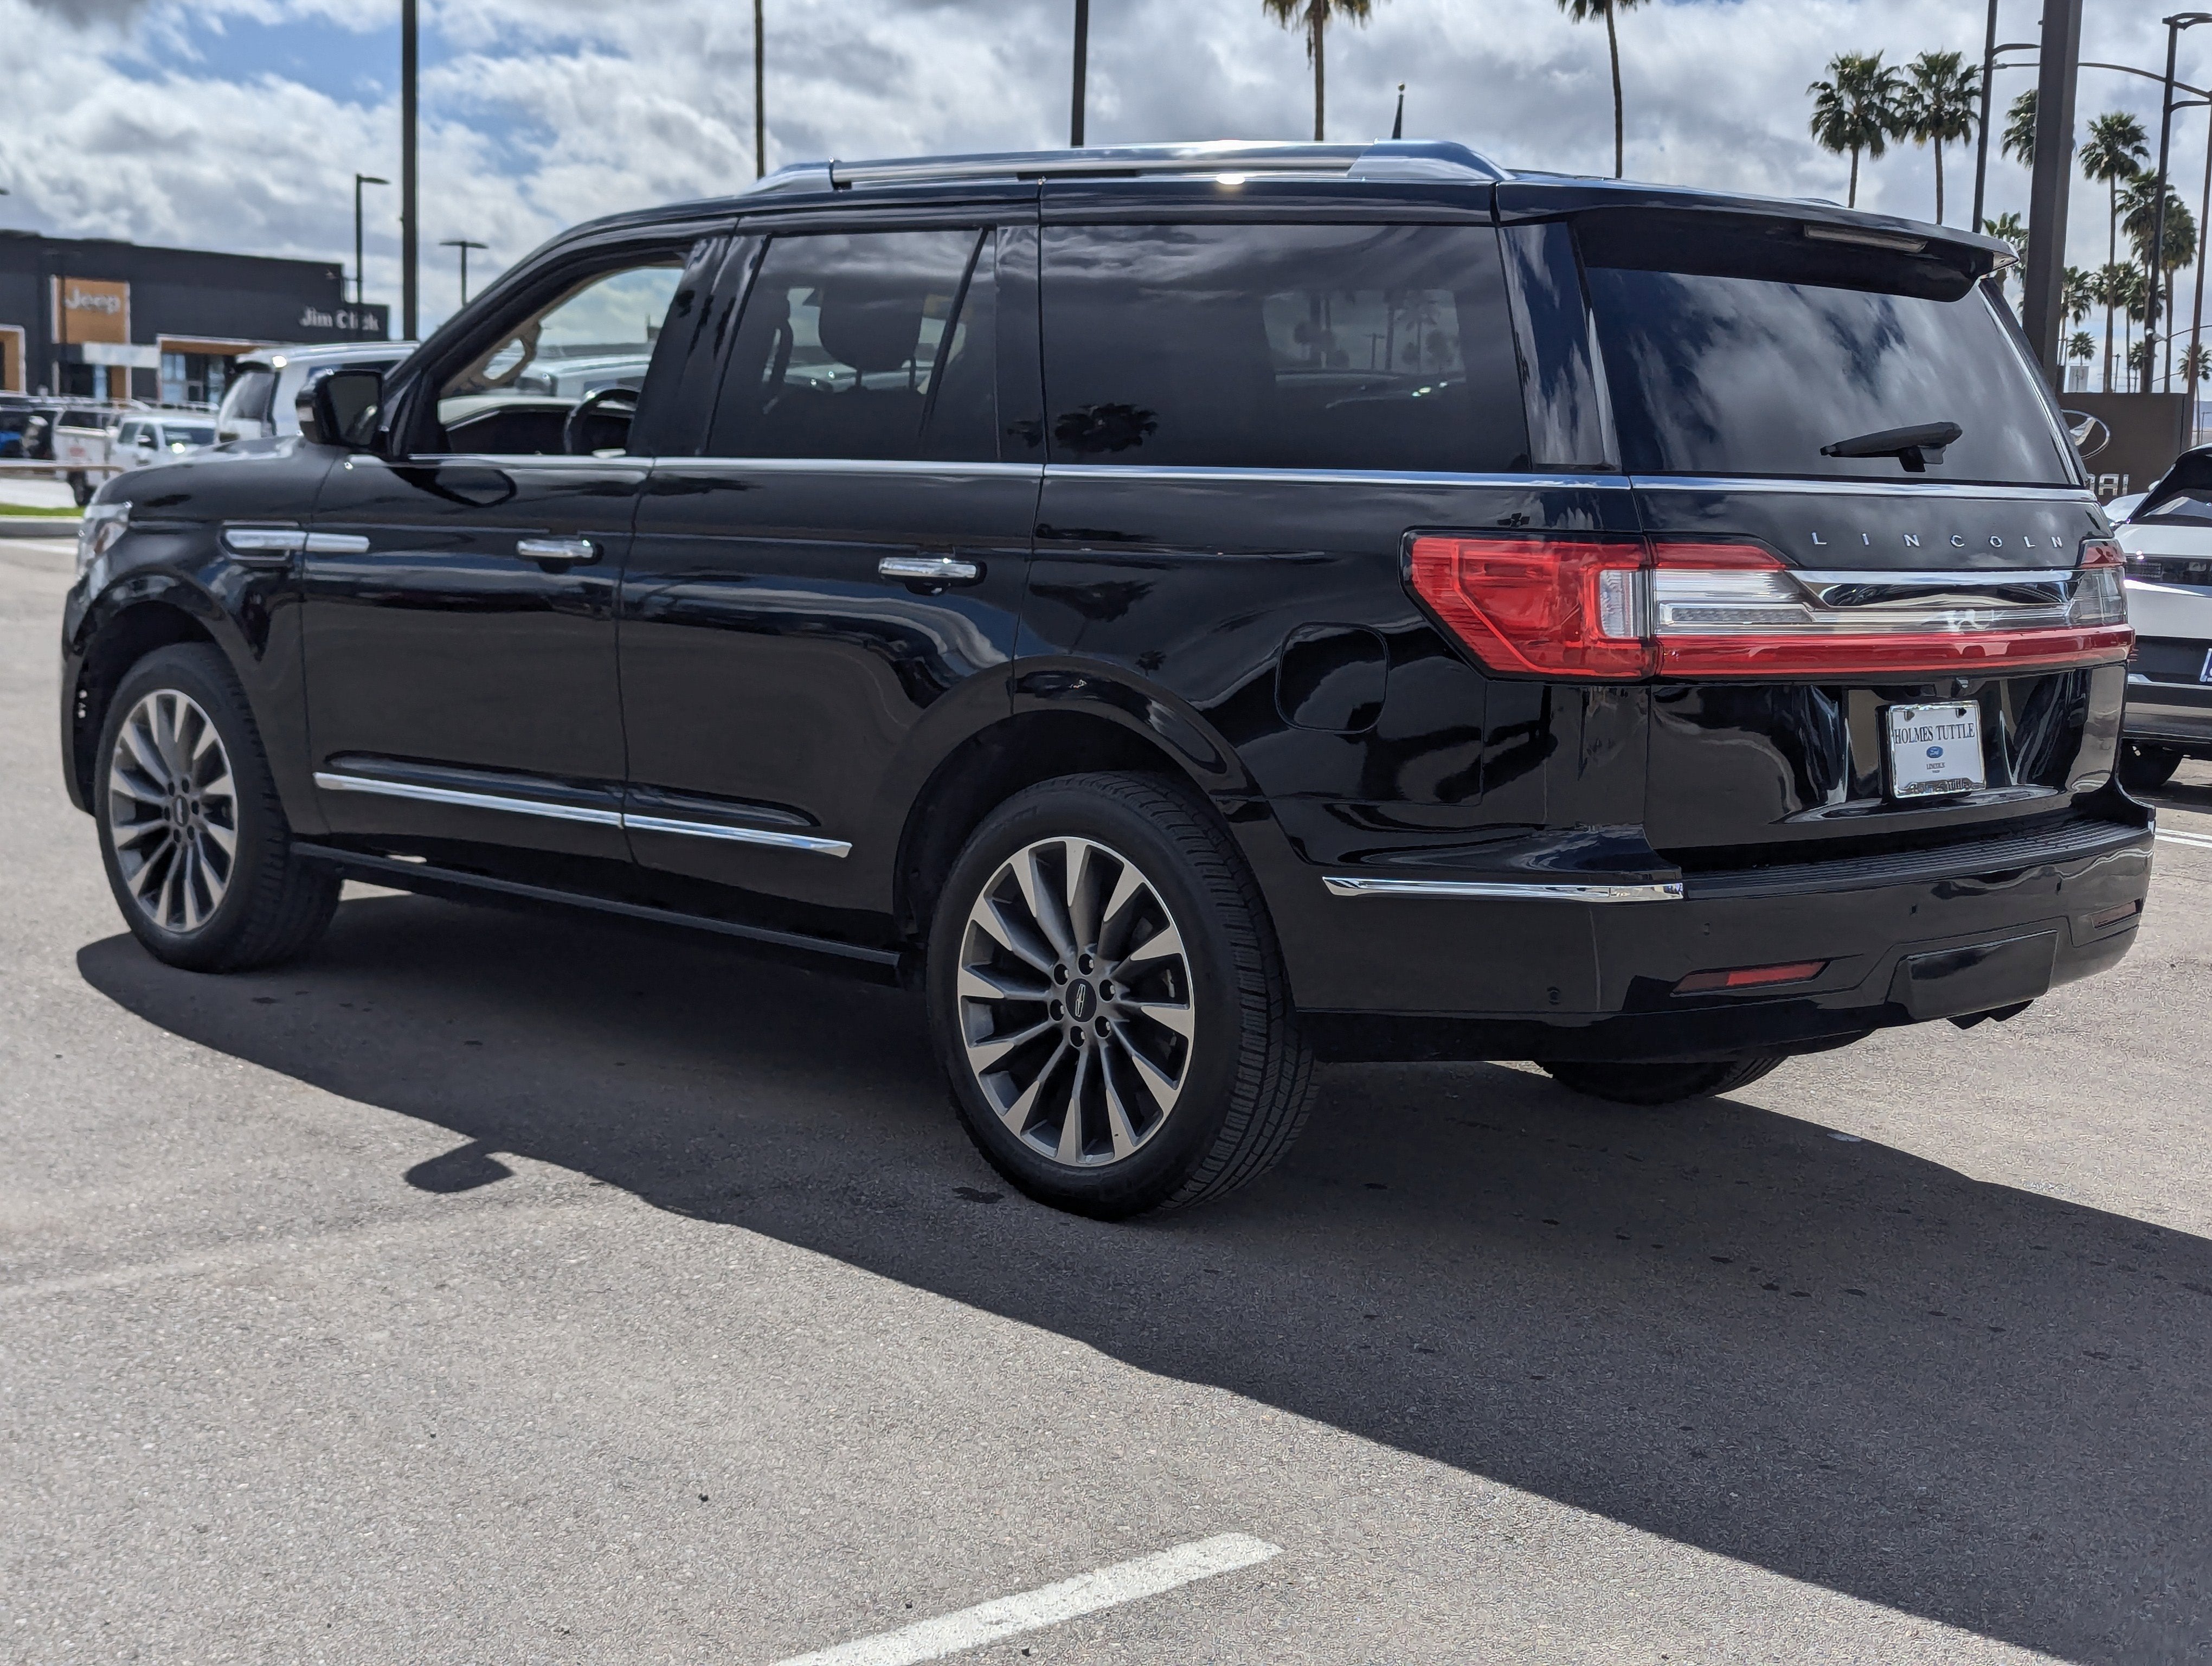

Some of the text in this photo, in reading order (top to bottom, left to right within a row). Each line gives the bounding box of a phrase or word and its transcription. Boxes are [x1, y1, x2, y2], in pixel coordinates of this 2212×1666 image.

[65, 286, 121, 315] Jeep
[298, 306, 333, 328] Jim
[1811, 531, 2063, 548] LINCOLN
[1894, 723, 1975, 744] HOLMES TUTTLE
